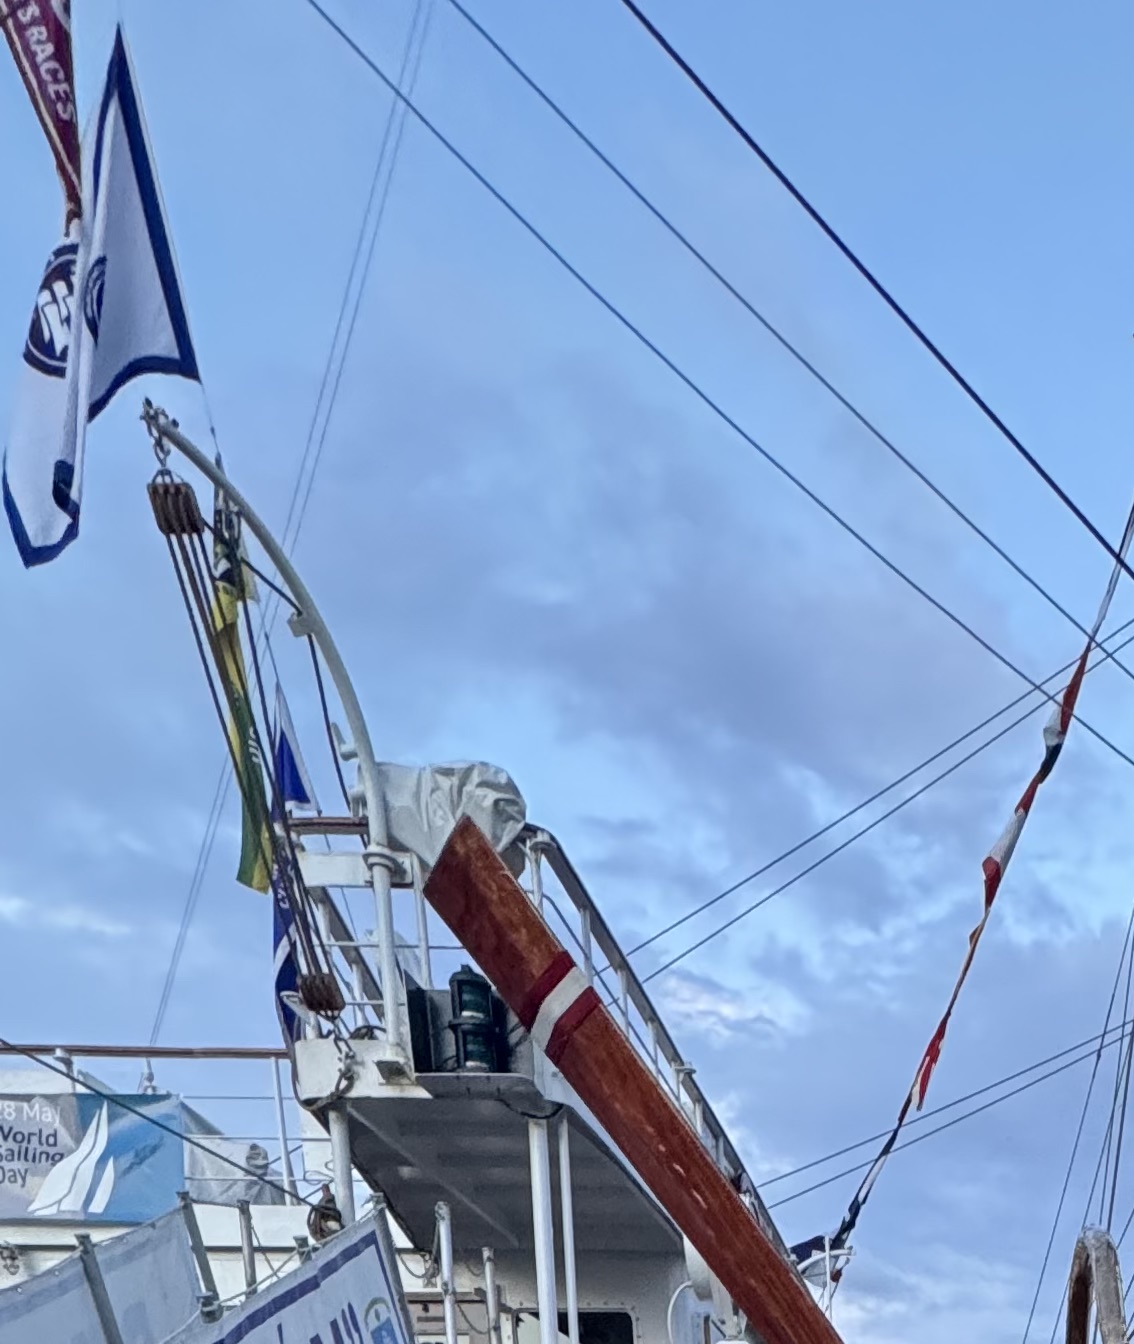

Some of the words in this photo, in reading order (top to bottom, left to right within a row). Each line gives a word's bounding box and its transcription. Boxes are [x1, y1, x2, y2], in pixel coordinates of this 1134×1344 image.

[25, 25, 76, 122] RACES
[0, 1101, 16, 1121] 8
[23, 1102, 61, 1127] May
